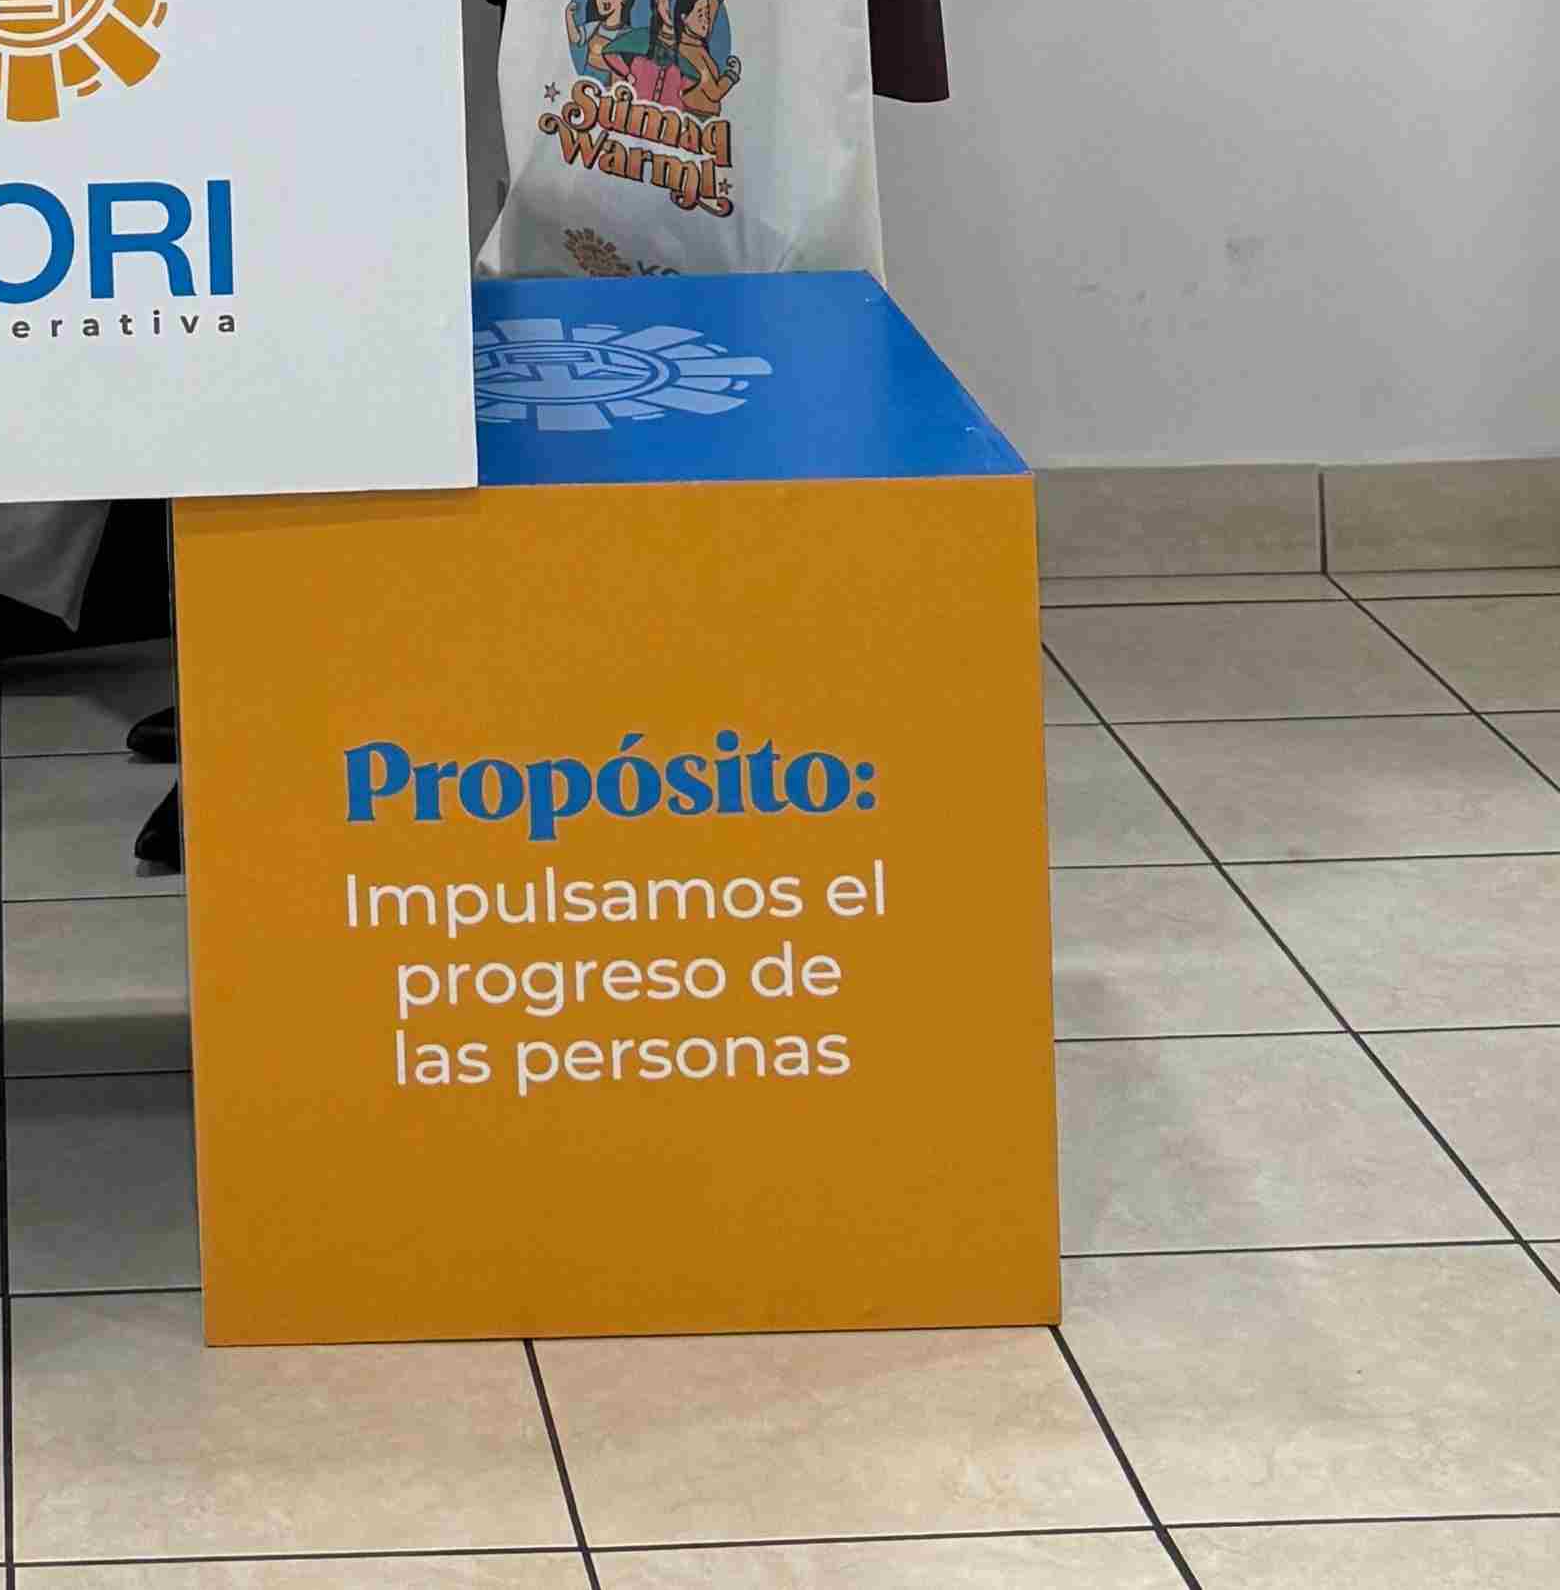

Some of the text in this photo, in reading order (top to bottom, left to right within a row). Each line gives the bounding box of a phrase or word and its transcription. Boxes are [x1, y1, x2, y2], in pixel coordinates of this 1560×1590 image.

[562, 80, 732, 168] Sumaq
[343, 729, 876, 842] Propósito:
[346, 859, 886, 939] Impulsamos el
[396, 940, 843, 1020] progreso de
[395, 1029, 852, 1097] las personas
